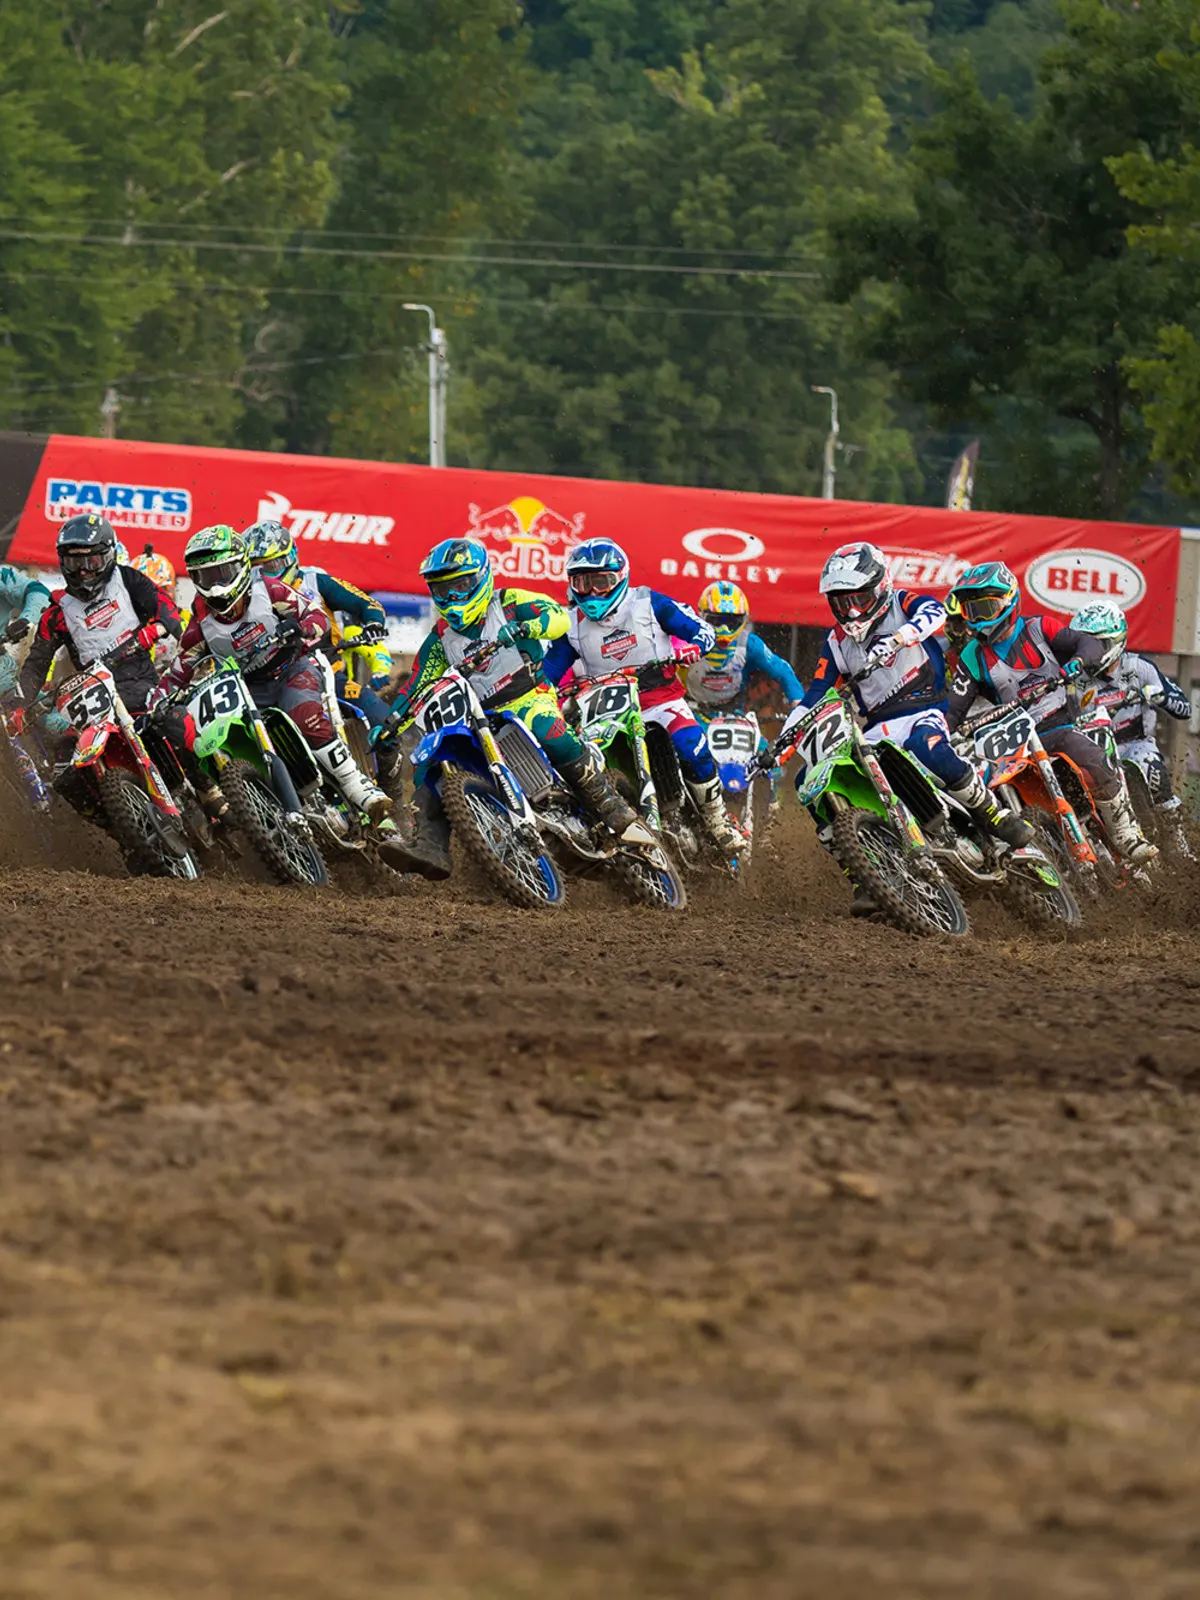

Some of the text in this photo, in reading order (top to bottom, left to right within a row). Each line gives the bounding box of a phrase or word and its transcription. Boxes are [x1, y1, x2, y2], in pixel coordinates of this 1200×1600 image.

[49, 482, 188, 513] PARTS
[289, 510, 396, 546] THOR
[660, 558, 784, 584] OAKLEY
[1047, 567, 1125, 596] BELL
[66, 684, 111, 730] 53
[199, 679, 240, 728] 43
[424, 684, 466, 733] 65
[584, 686, 630, 725] 18
[712, 728, 756, 750] 93
[983, 718, 1031, 761] 68
